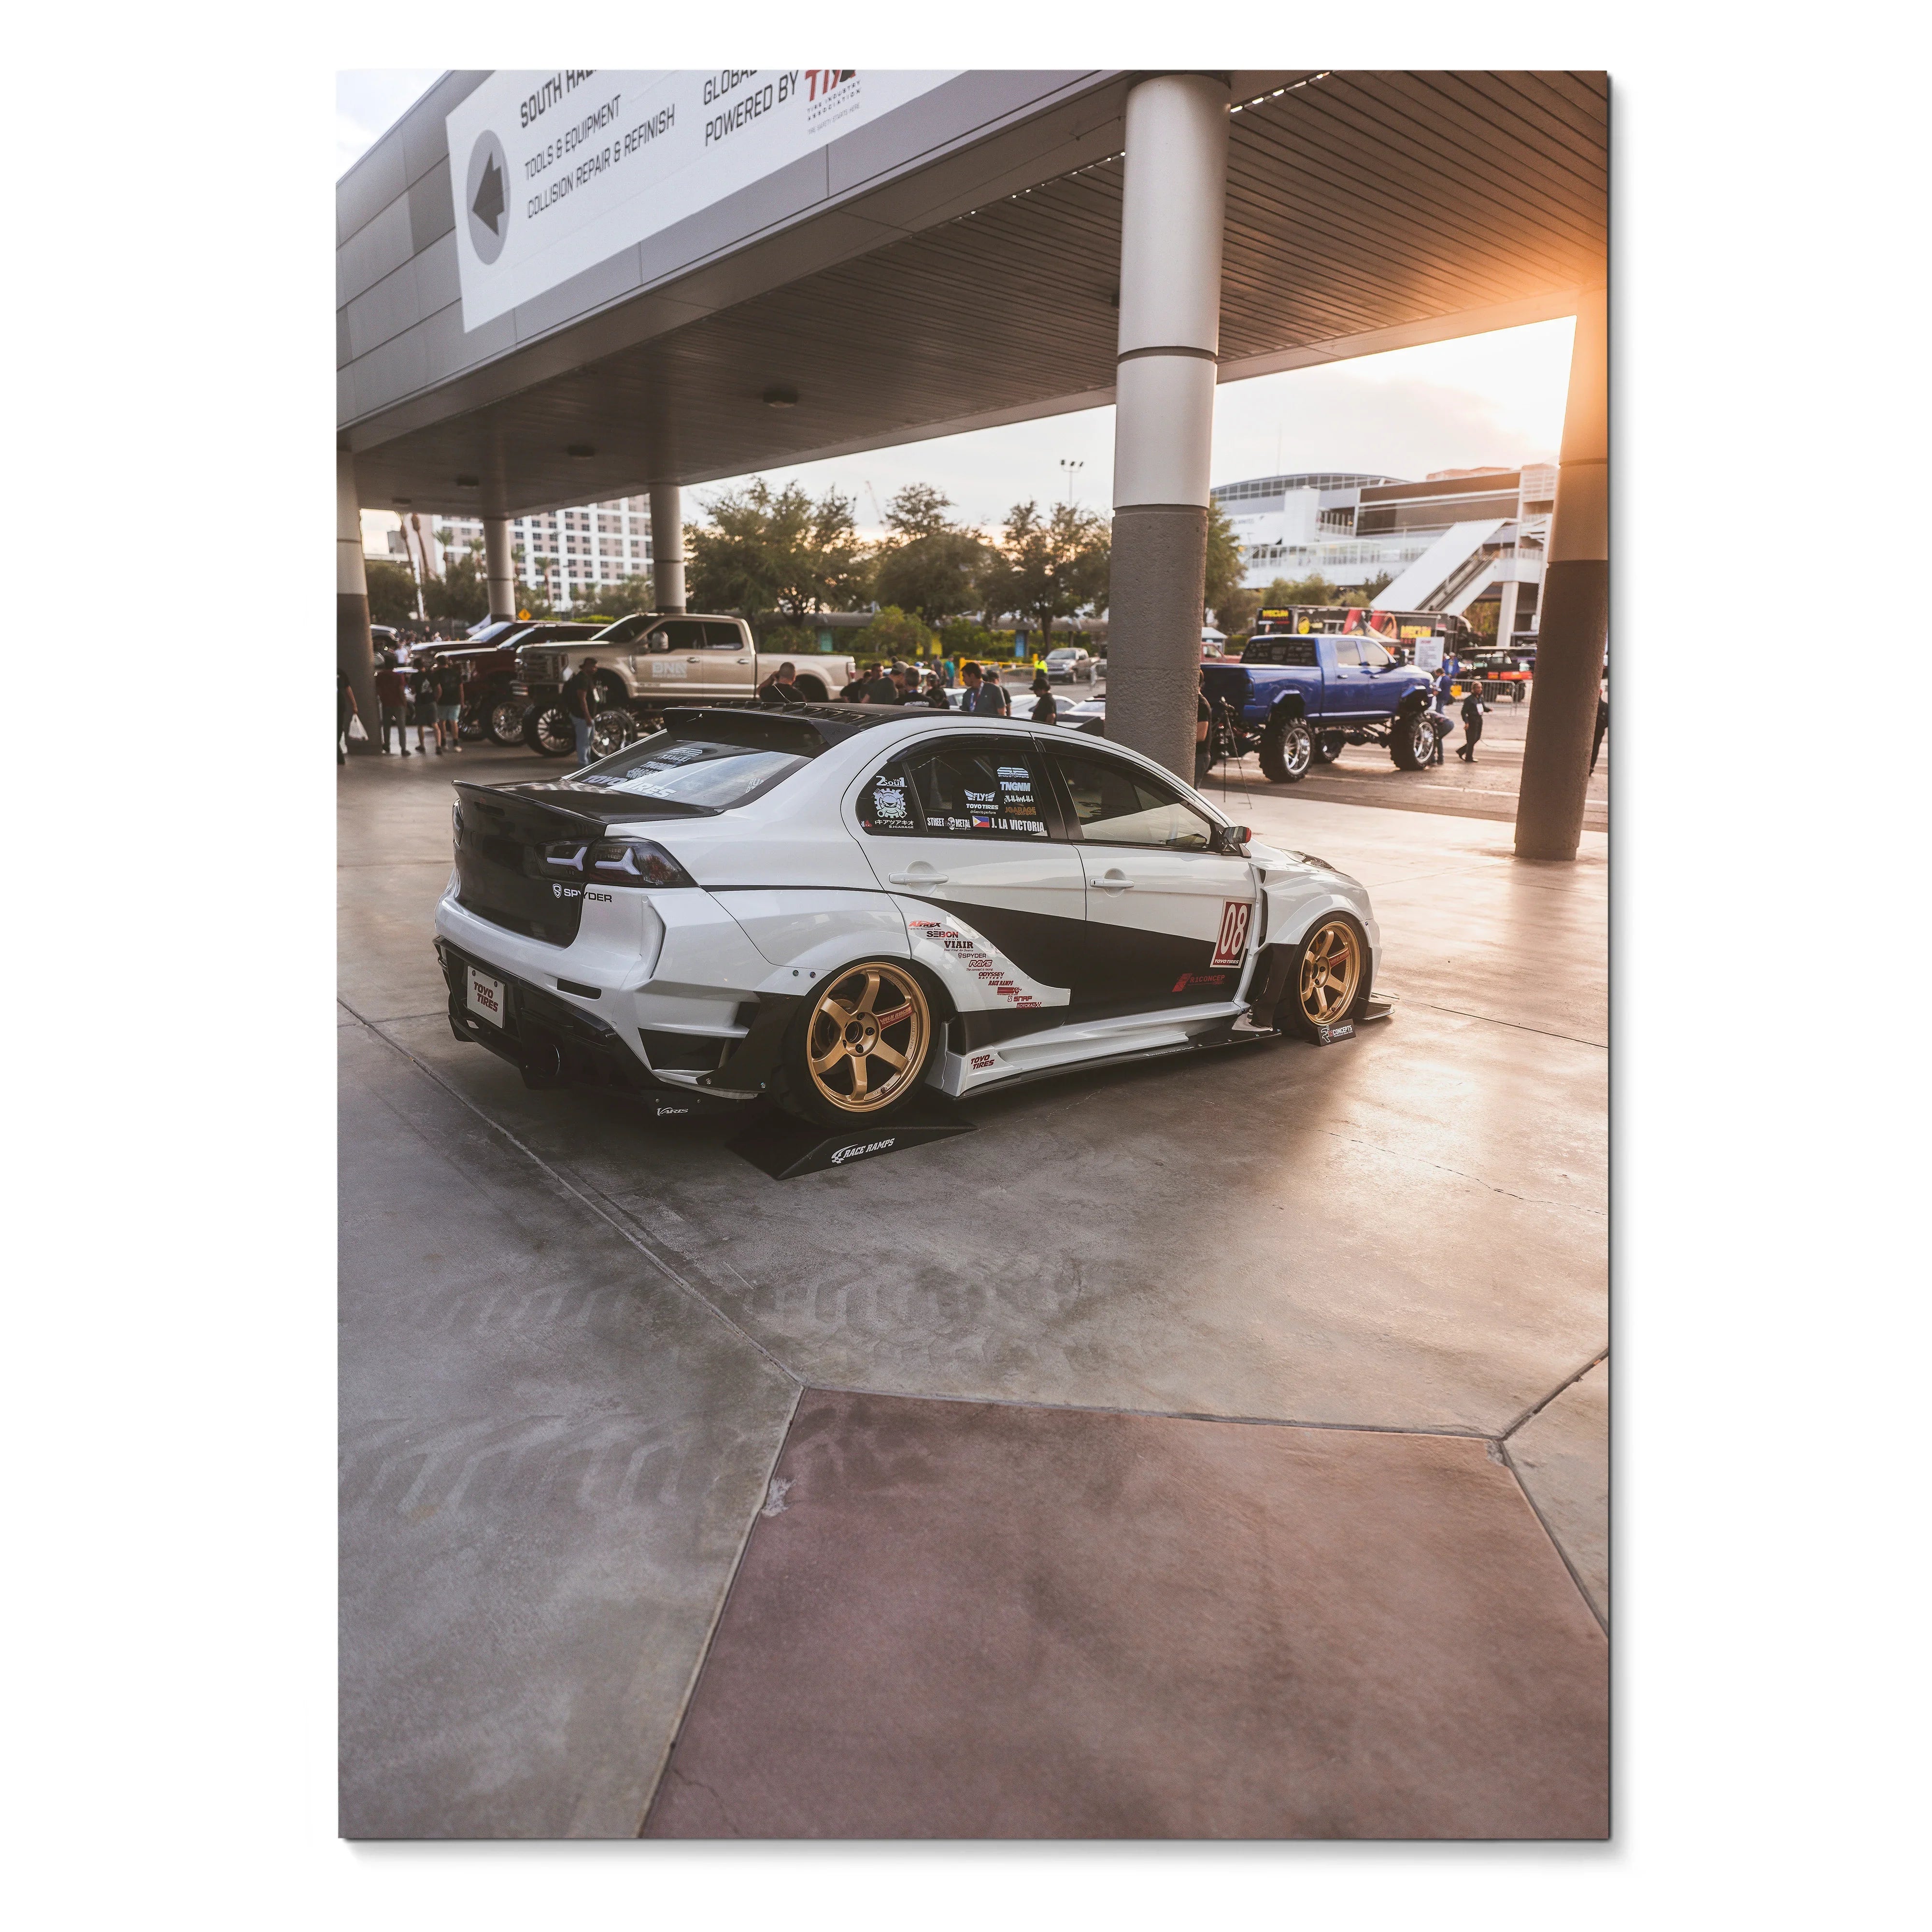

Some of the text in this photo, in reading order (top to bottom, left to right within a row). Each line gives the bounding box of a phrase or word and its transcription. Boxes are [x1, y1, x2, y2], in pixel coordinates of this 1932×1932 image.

[521, 70, 597, 128] SOUTH HA
[705, 70, 799, 146] POWERED BY
[525, 94, 622, 180] TOOLS & EQUIPMENT
[527, 103, 676, 219] COLLISION REPAIR & REFINISH
[581, 775, 628, 786] TOYO
[619, 780, 677, 797] TIRES
[1000, 781, 1031, 792] TNGNM
[927, 817, 971, 830] STREET METAL
[991, 818, 1045, 832] J. LA VICTORIA
[564, 888, 612, 902] SPYDER
[1221, 904, 1248, 955] 08
[944, 940, 974, 949] VIAIR
[474, 981, 493, 999] TOYO
[477, 993, 498, 1012] TIRES
[971, 1054, 990, 1065] TOYO
[973, 1059, 994, 1070] TIRES
[843, 1138, 895, 1158] RACE RAMPS
